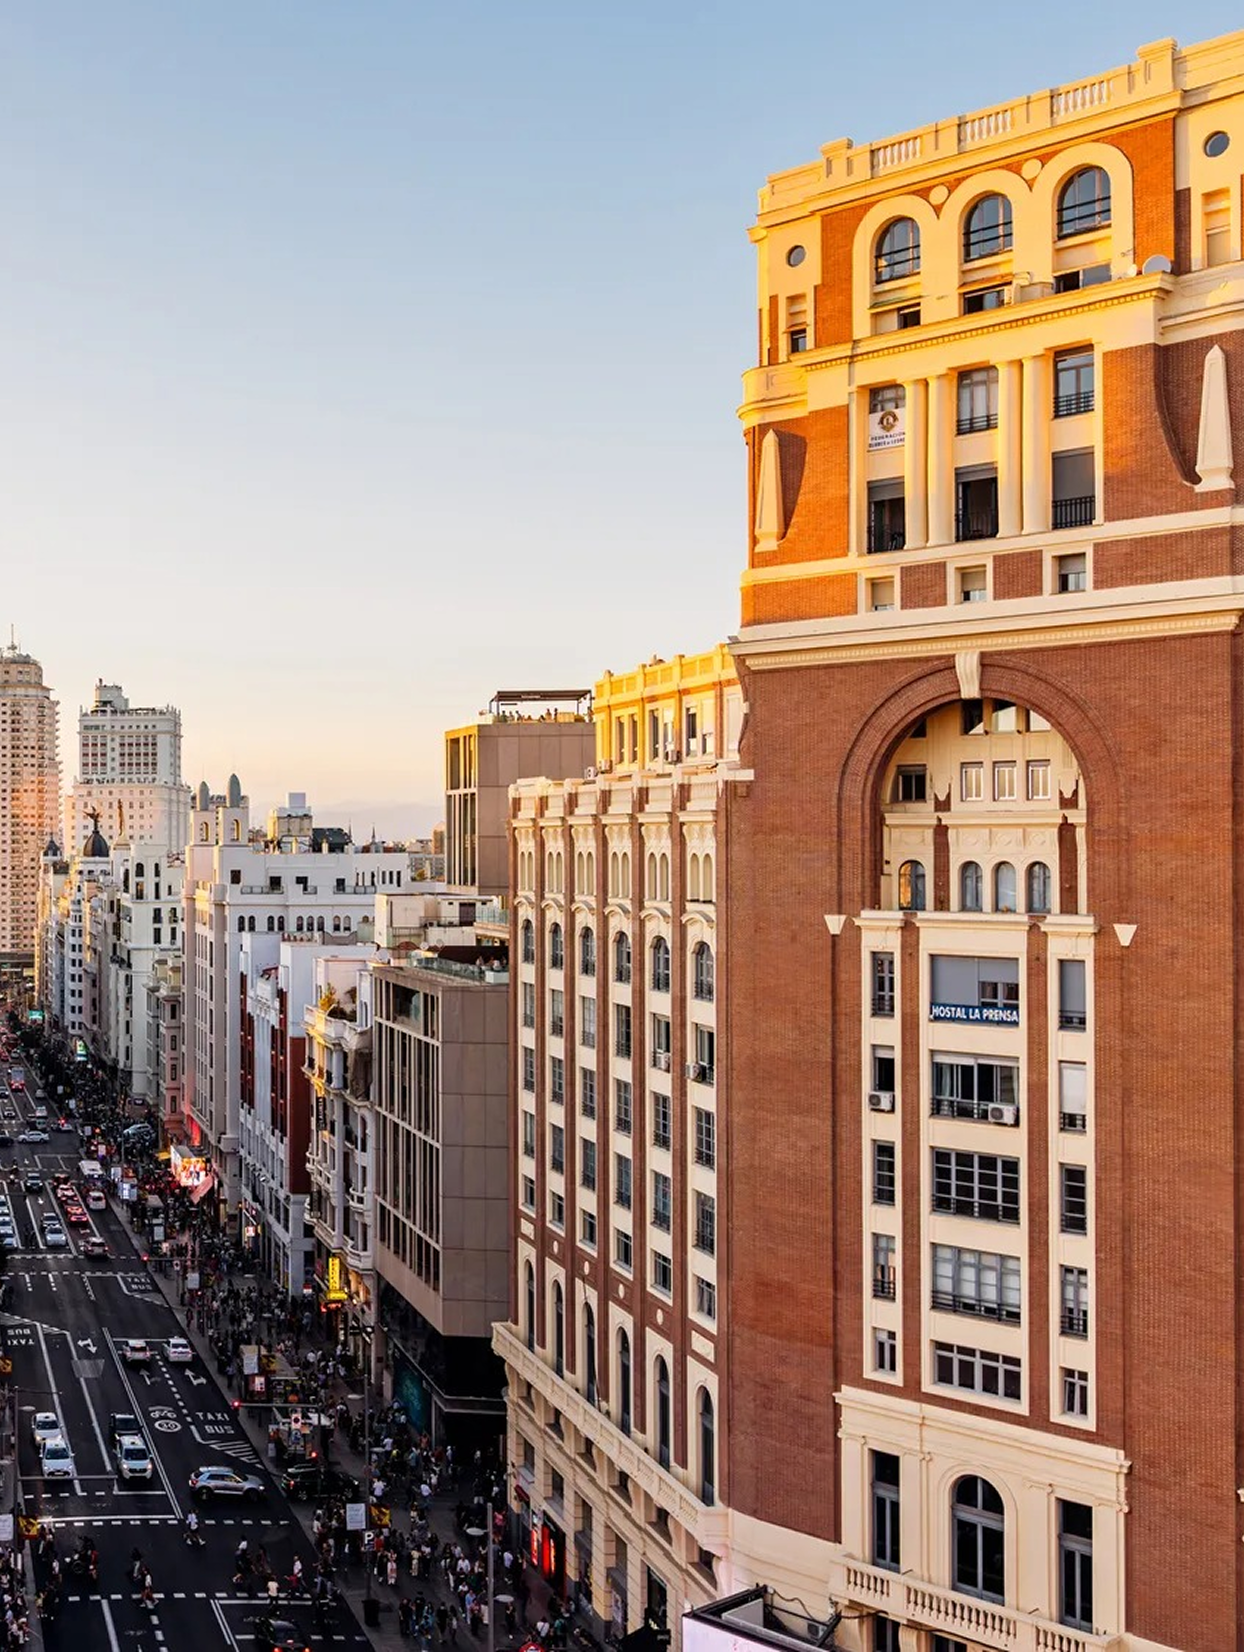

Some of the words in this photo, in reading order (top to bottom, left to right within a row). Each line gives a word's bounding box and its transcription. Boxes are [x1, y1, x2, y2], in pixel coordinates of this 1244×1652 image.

[931, 1004, 967, 1019] HOSTAL
[969, 1008, 981, 1019] LA
[982, 1009, 1019, 1022] PRENSA
[7, 1338, 35, 1346] TAXI
[196, 1412, 230, 1421] TAXI
[204, 1425, 235, 1434] BUS
